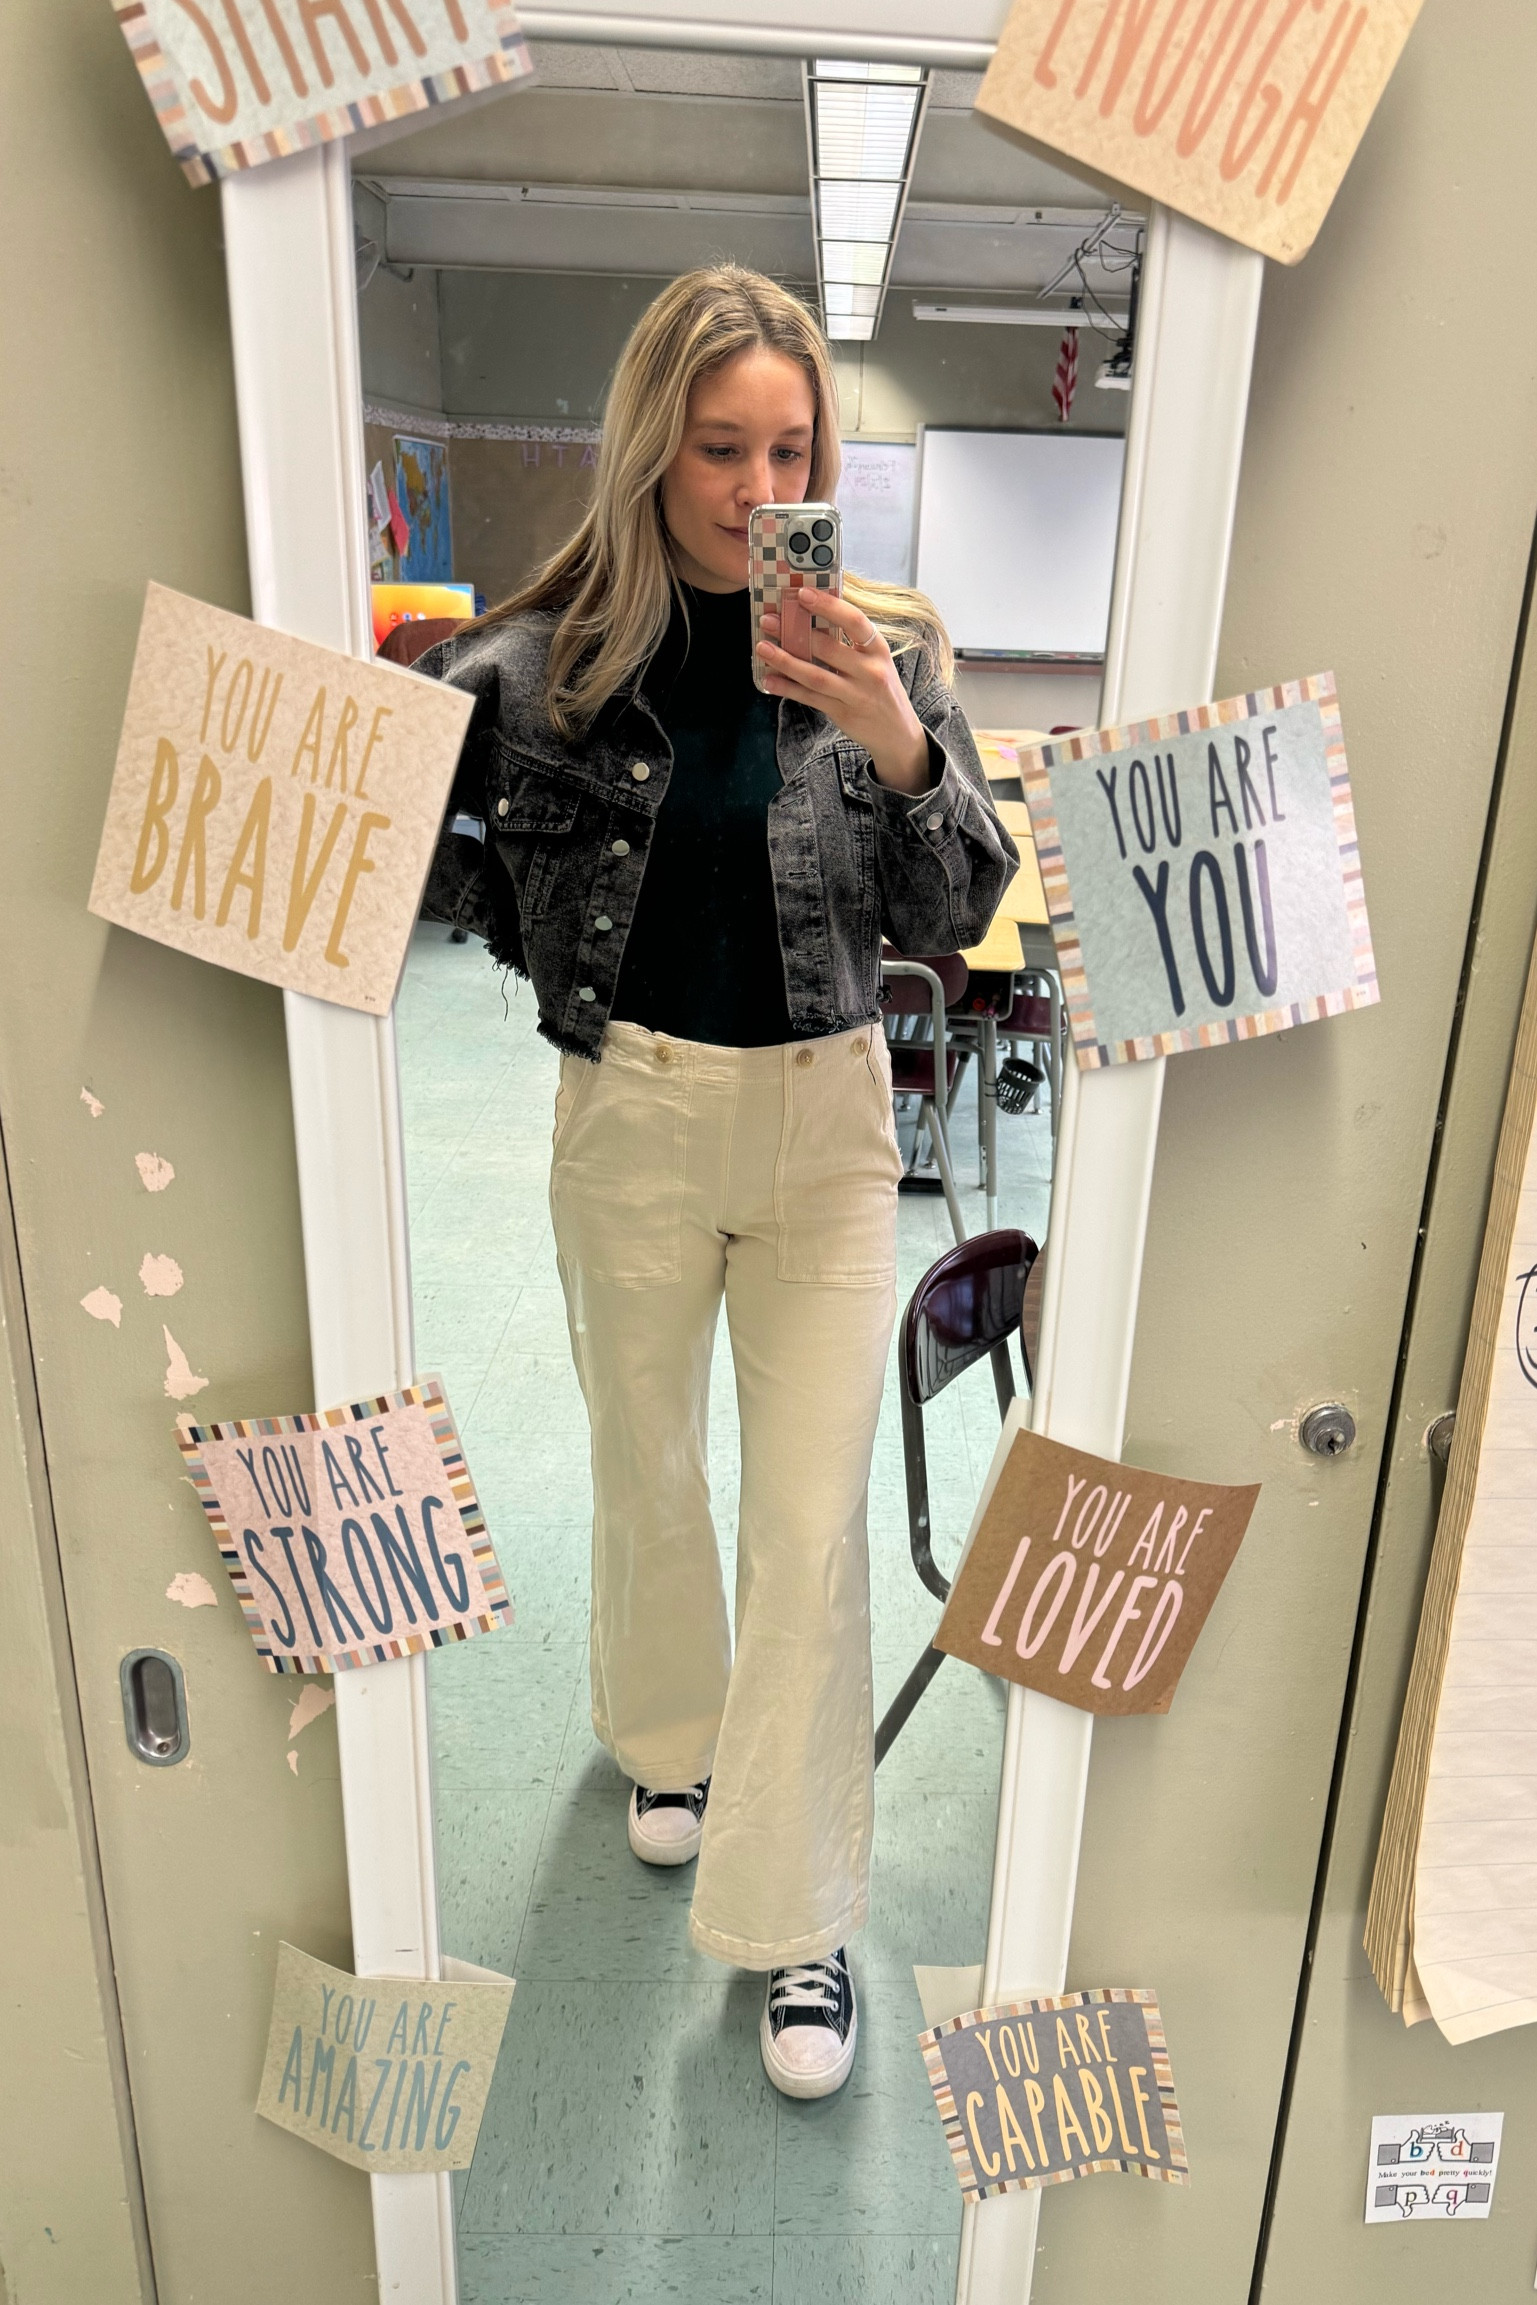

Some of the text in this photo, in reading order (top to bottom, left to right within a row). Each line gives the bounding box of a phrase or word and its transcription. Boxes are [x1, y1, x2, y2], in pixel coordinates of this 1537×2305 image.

[200, 645, 393, 800] YOU ARE
[1096, 726, 1286, 859] YOU ARE
[130, 738, 392, 968] BRAVE
[1132, 839, 1278, 1017] YOU
[236, 1426, 404, 1518] YOU ARE
[1052, 1474, 1213, 1575] YOU ARE
[243, 1495, 470, 1648] STRONG
[981, 1536, 1184, 1692] LOVED
[322, 1983, 458, 2056] YOU ARE
[975, 2010, 1118, 2081] YOU ARE
[278, 2025, 472, 2151] AMAZING
[966, 2066, 1160, 2177] CAPABLE
[1378, 2168, 1492, 2179] Make your bed pretty quickly!
[1405, 2188, 1459, 2206] p q
[1409, 2140, 1464, 2158] b d
